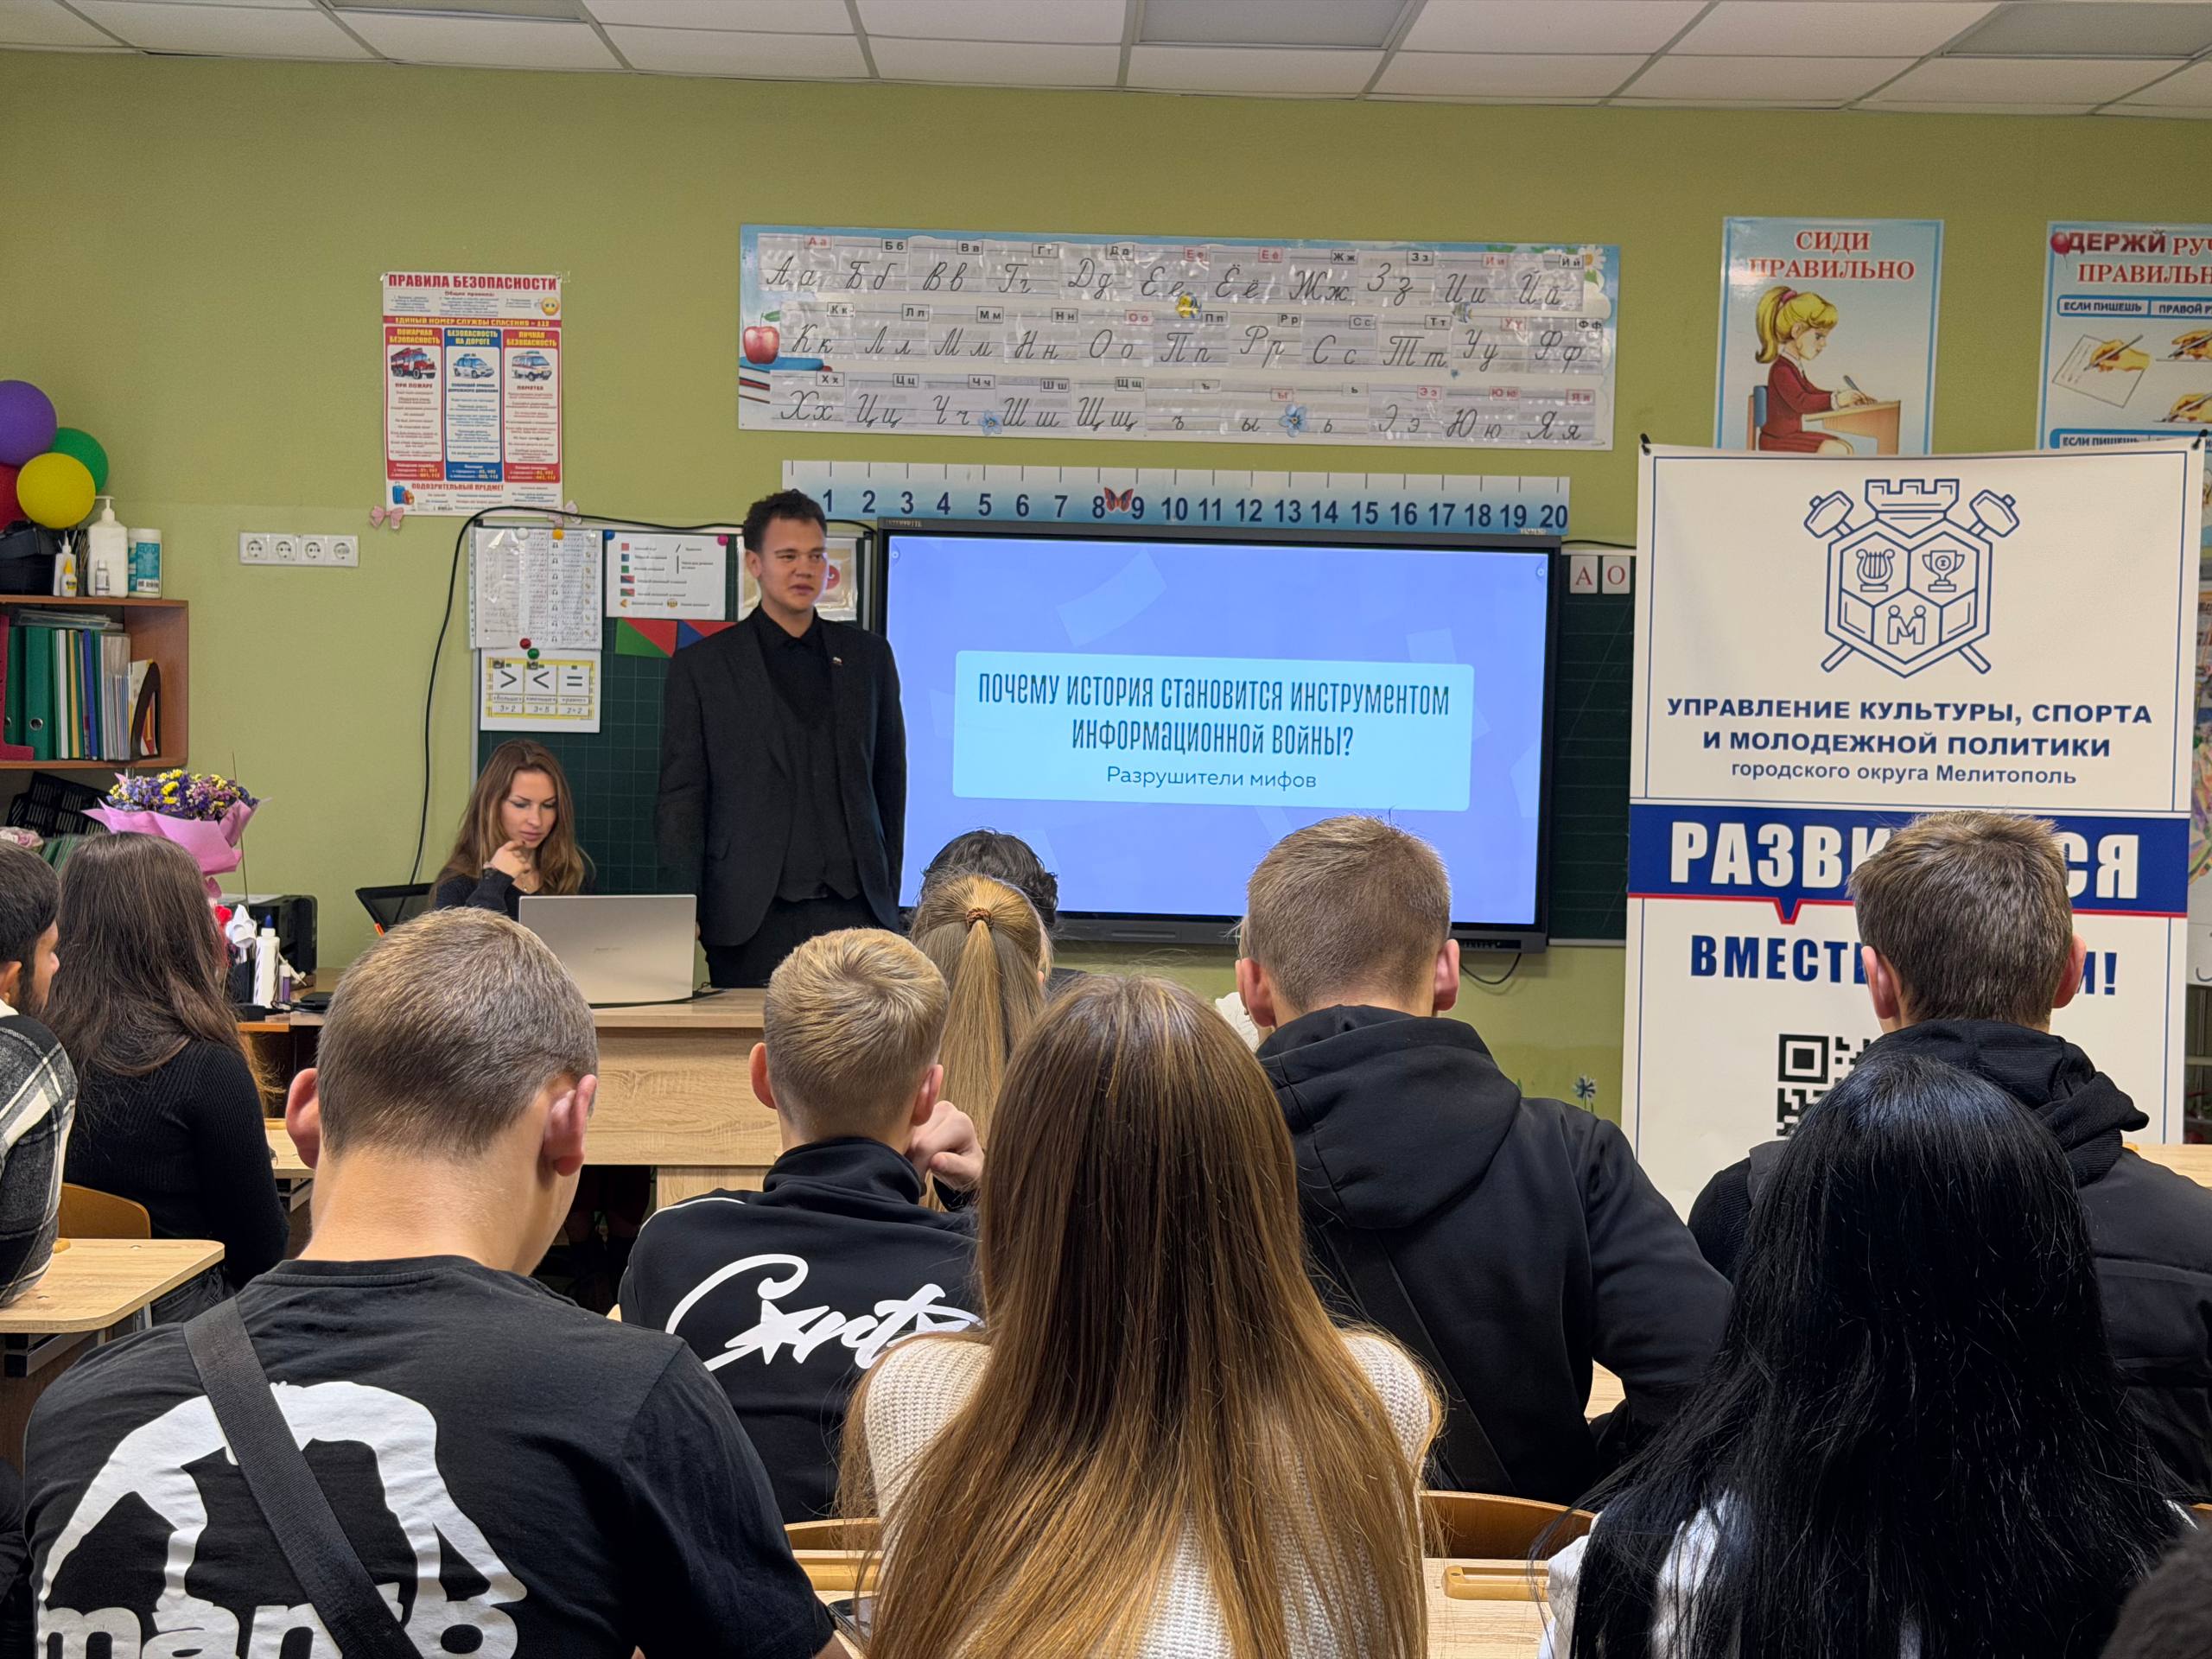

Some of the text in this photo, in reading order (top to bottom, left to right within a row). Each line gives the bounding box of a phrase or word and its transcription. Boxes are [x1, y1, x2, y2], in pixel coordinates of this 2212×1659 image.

[1796, 231, 1871, 254] СИДИ
[1748, 258, 1916, 280] ПРАВИЛЬНО
[389, 274, 556, 290] ПРАВИЛА БЕЗОПАСНОСТИ
[2063, 302, 2142, 312] ЕСЛИ ПИШЕШЬ
[823, 489, 1568, 528] 1 2 3 4 5 6 7 8 9 10 11 12 13 14 15 16 17 18 19 20
[1668, 697, 2152, 727] УПРАВЛЕНИЕ КУЛЬТУРЫ, СПОРТА
[1703, 728, 2111, 758] И МОЛОДЕЖНОЙ ПОЛИТИКИ
[1107, 766, 1317, 791] Разрушители мифов
[1732, 762, 2077, 785] городского округа Мелитополь
